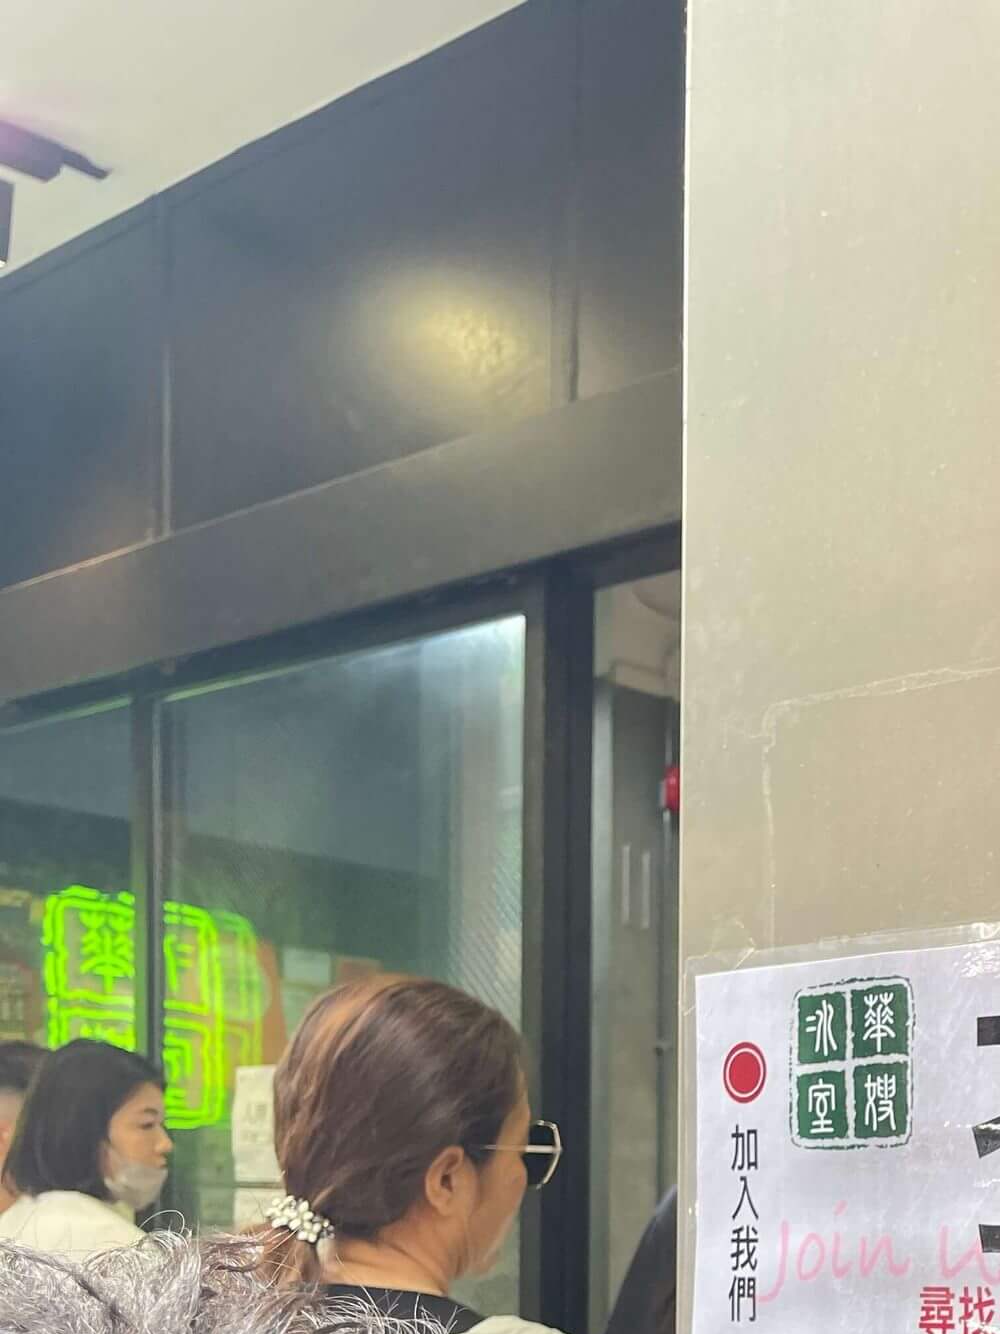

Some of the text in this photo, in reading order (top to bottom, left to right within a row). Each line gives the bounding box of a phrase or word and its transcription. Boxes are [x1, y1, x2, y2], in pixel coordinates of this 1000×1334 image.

[728, 1124, 760, 1323] 加入我們
[755, 1200, 913, 1303] Join
